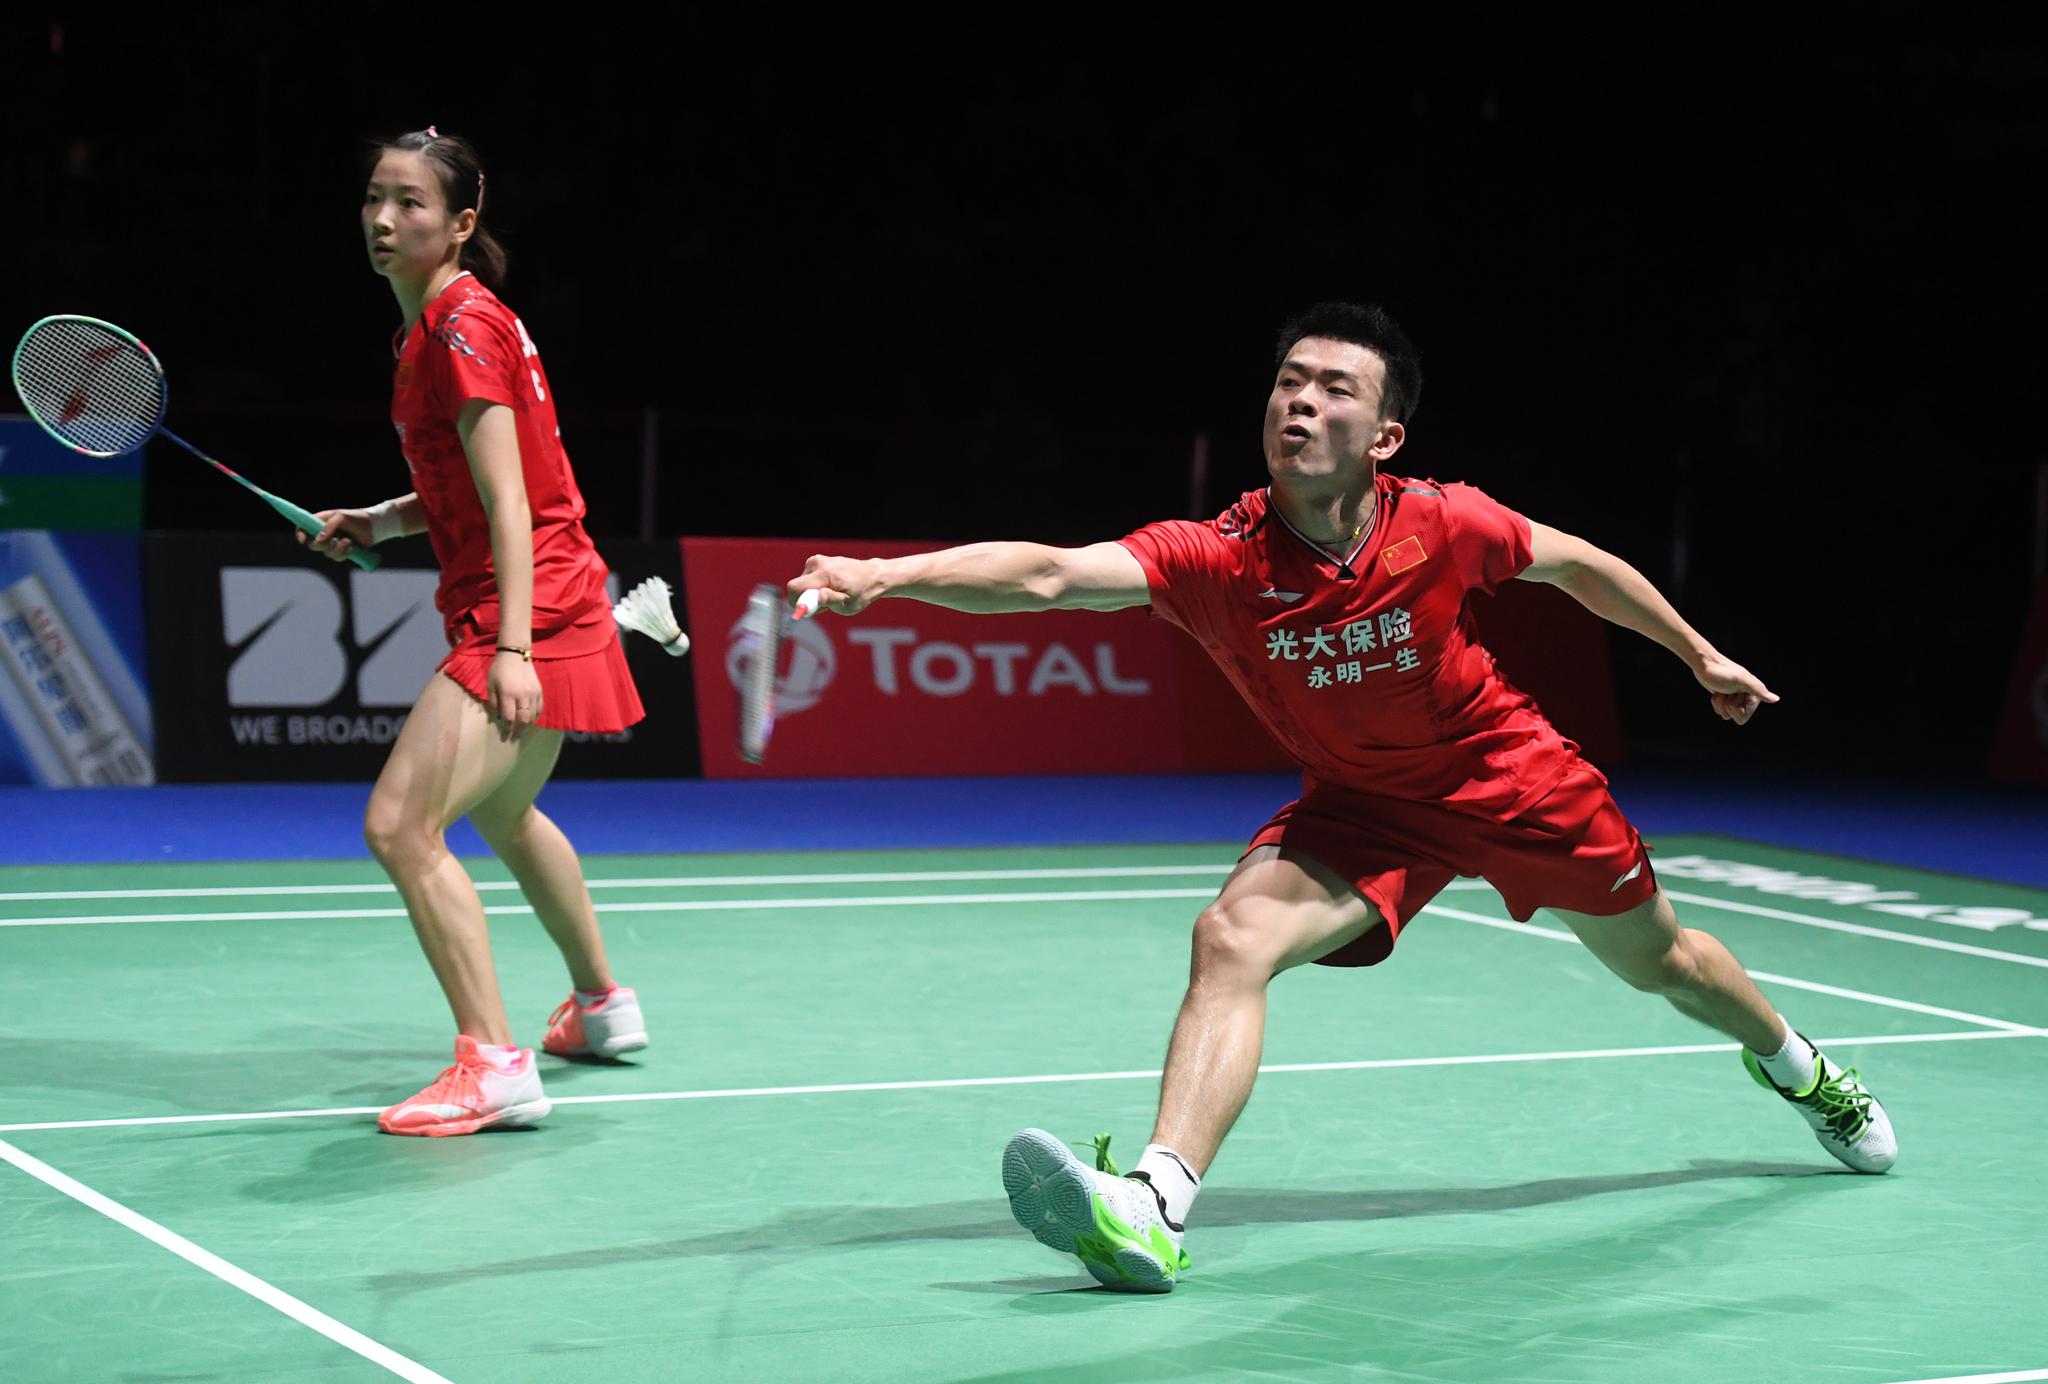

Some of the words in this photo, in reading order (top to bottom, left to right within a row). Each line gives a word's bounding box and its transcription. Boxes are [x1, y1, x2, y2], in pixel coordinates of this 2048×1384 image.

[1266, 607, 1415, 661] 光大保险
[1308, 647, 1421, 689] 永明一生
[230, 715, 281, 744] WE
